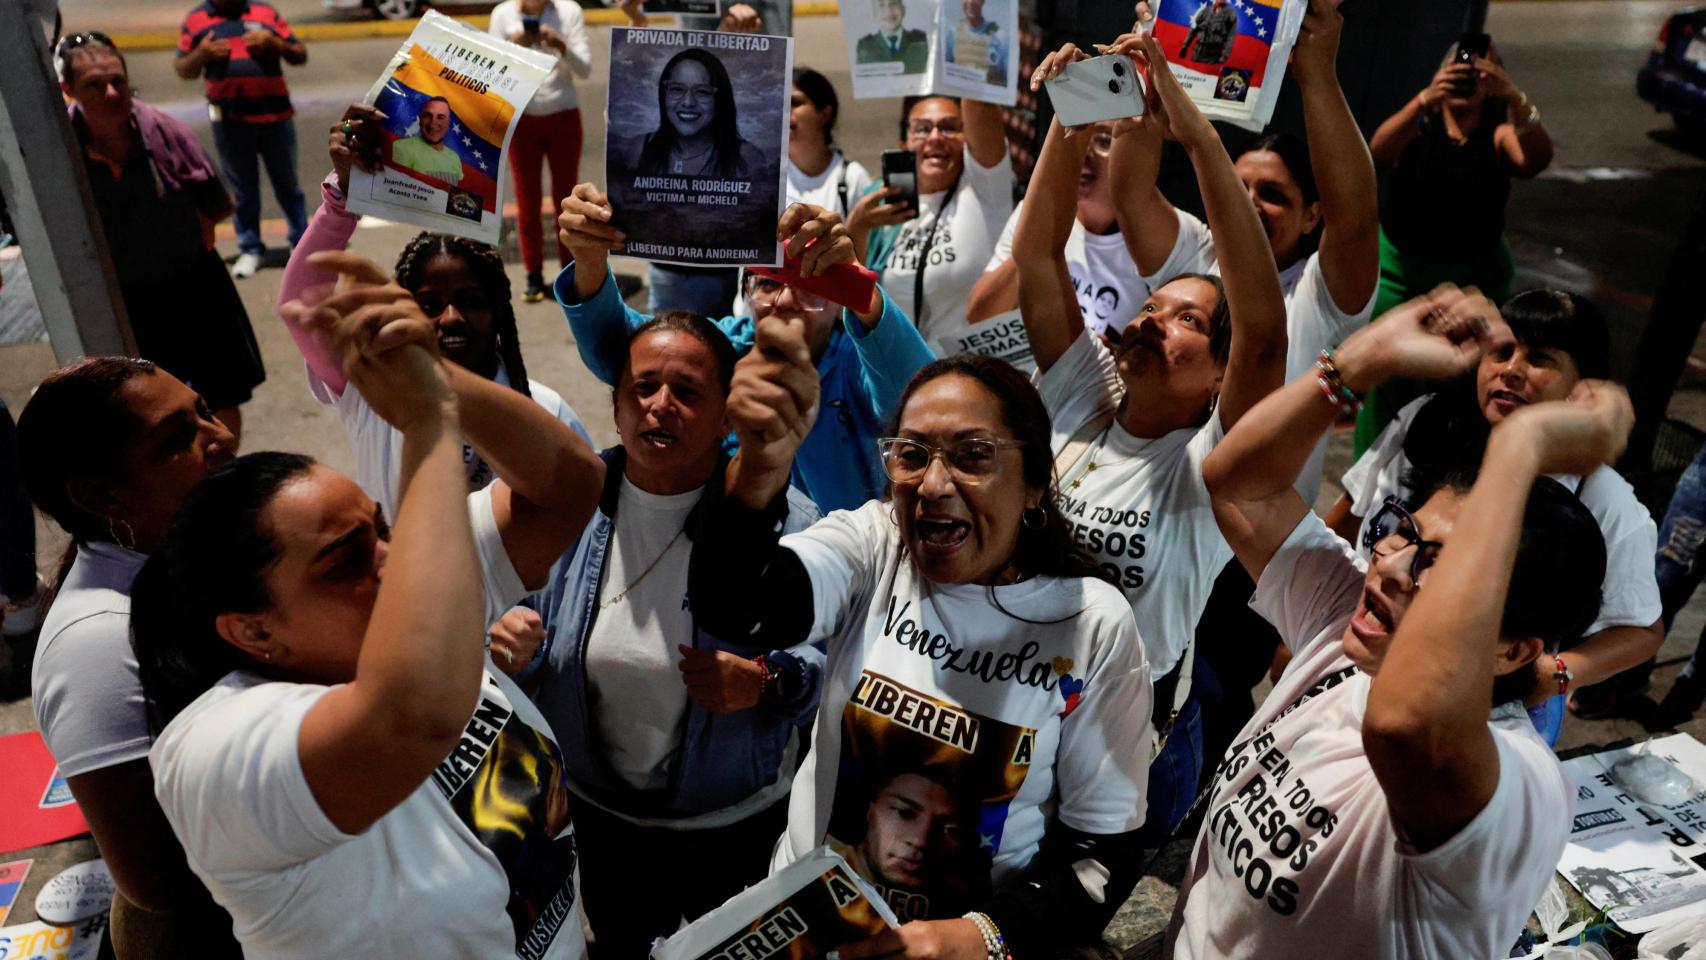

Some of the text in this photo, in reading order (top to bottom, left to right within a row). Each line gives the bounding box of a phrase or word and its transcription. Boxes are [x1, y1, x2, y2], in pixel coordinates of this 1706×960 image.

[626, 29, 770, 52] PRIVADA DE LIBERTAD
[445, 43, 509, 75] LIBEREN A
[633, 176, 751, 194] ANDREINA RODRÍGUEZ
[697, 194, 738, 206] MICHELO
[627, 242, 759, 260] ¡LIBERTAD PARA ANDREINA!
[958, 319, 1025, 352] JESÚS
[1090, 506, 1152, 529] TODOS
[884, 595, 1057, 692] Venezuela
[850, 675, 979, 755] LIBEREN
